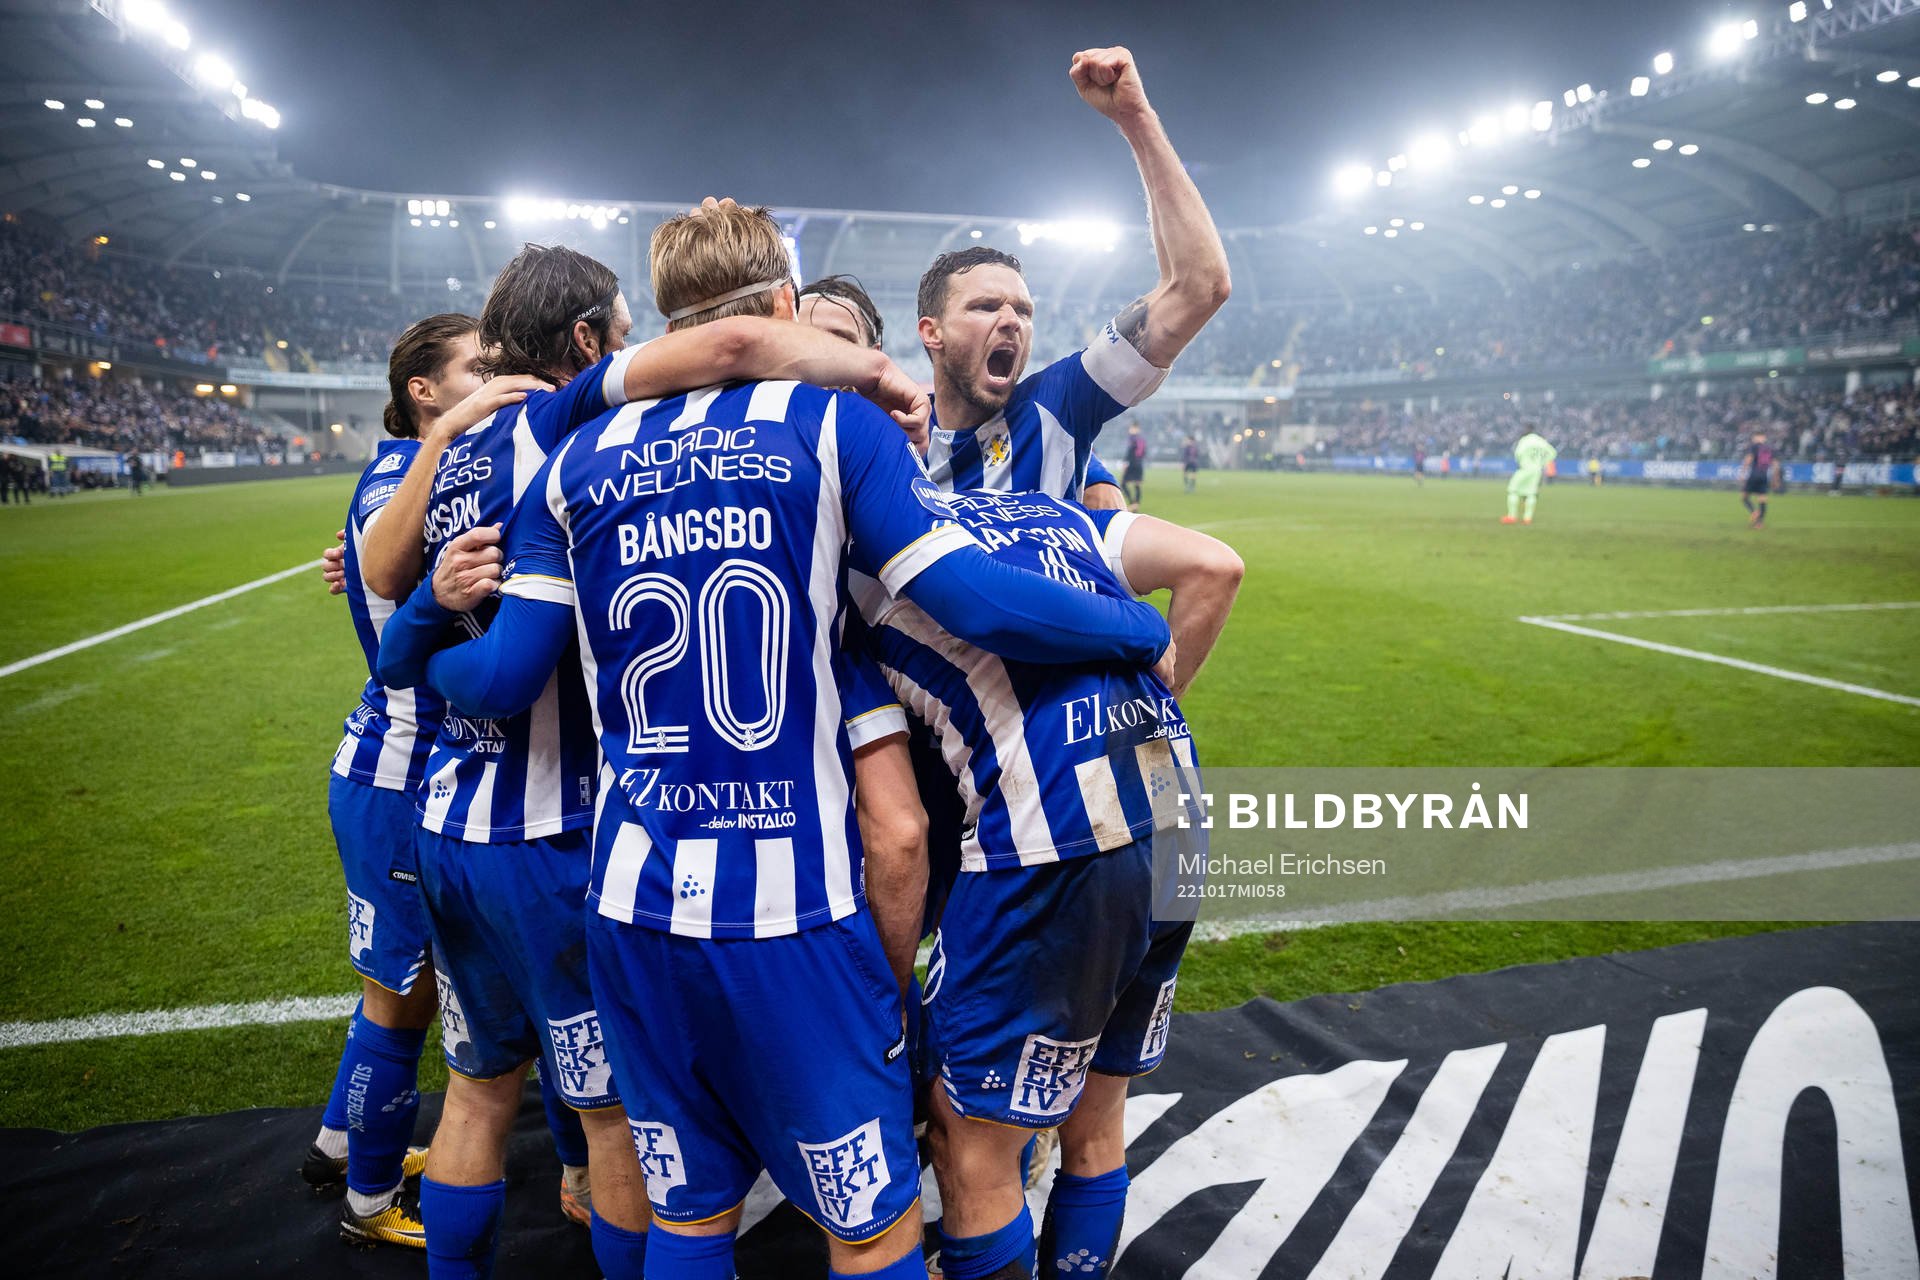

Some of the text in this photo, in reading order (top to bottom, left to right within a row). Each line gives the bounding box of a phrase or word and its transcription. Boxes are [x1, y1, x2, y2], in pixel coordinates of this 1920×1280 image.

[620, 426, 757, 470] NORDIC
[588, 453, 792, 506] WELLNESS
[618, 506, 772, 567] BÅNGSBO
[608, 559, 791, 754] 20
[738, 811, 797, 829] INSTALCO
[550, 1016, 601, 1049] EFF
[1029, 1040, 1095, 1068] EFF
[560, 1069, 589, 1092] IV
[1018, 1083, 1062, 1111] IV
[805, 1130, 867, 1174] EFF
[814, 1152, 879, 1198] EKT
[821, 1195, 853, 1223] IV
